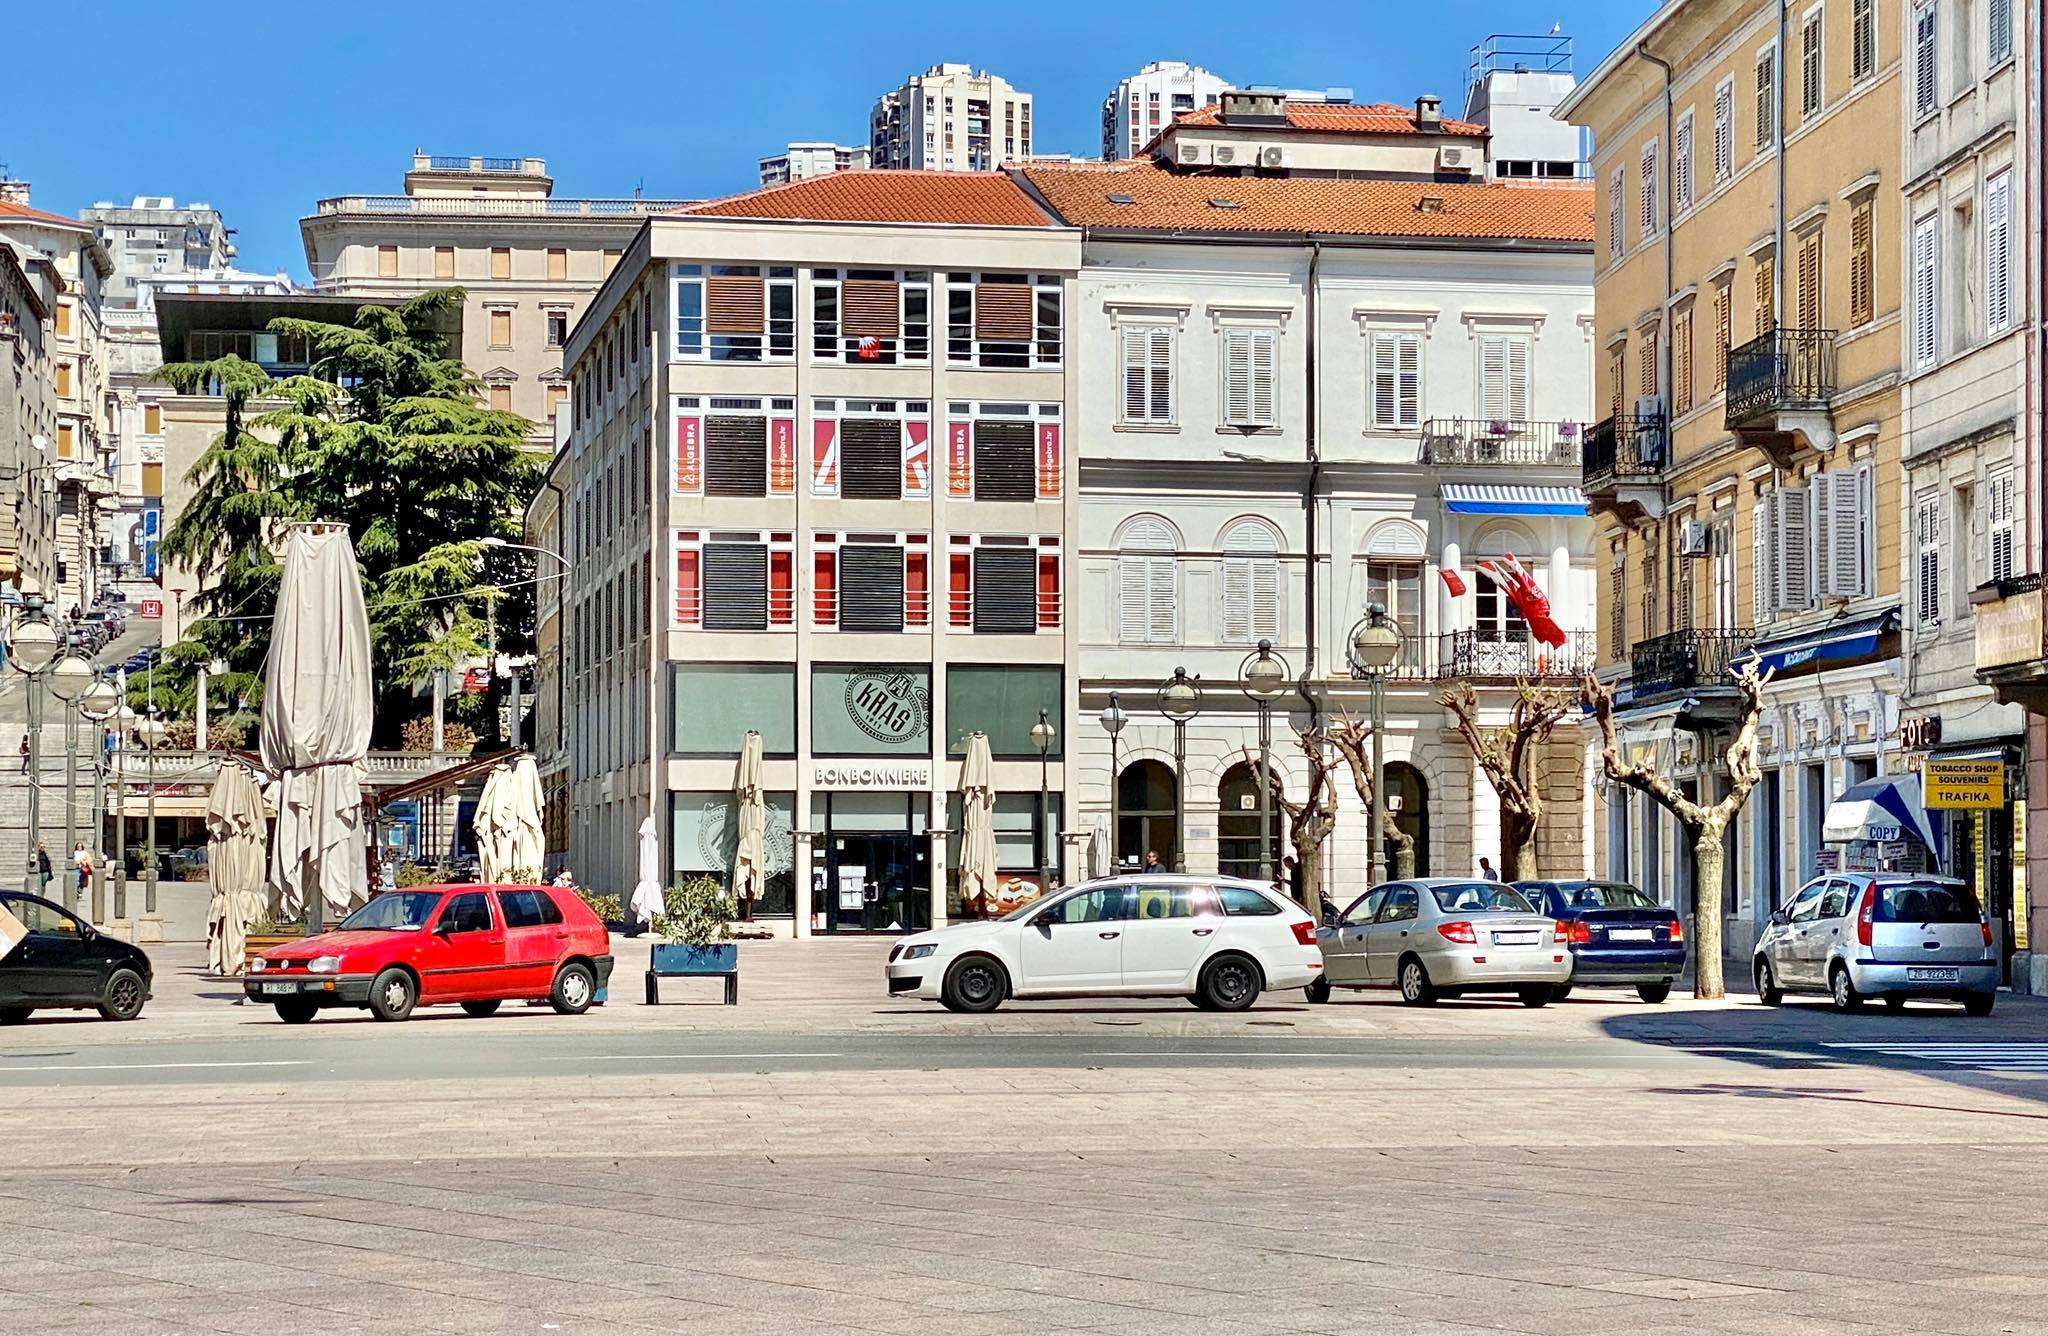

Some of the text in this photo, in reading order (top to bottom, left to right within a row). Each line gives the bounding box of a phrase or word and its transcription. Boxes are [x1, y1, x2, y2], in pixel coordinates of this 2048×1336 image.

[686, 423, 696, 472] ALGEBRA
[778, 425, 788, 487] www.algebra.hr
[956, 428, 965, 476] ALGEBRA
[1044, 431, 1053, 491] www.algebra.hr
[855, 682, 912, 732] KRAŠ
[814, 767, 928, 786] BONBONNIERE
[1930, 765, 1999, 773] TOBACCO SHOP
[1938, 776, 1990, 784] SOUVENIRS
[1937, 792, 1991, 801] TRAFIKA
[1869, 826, 1898, 840] COPY
